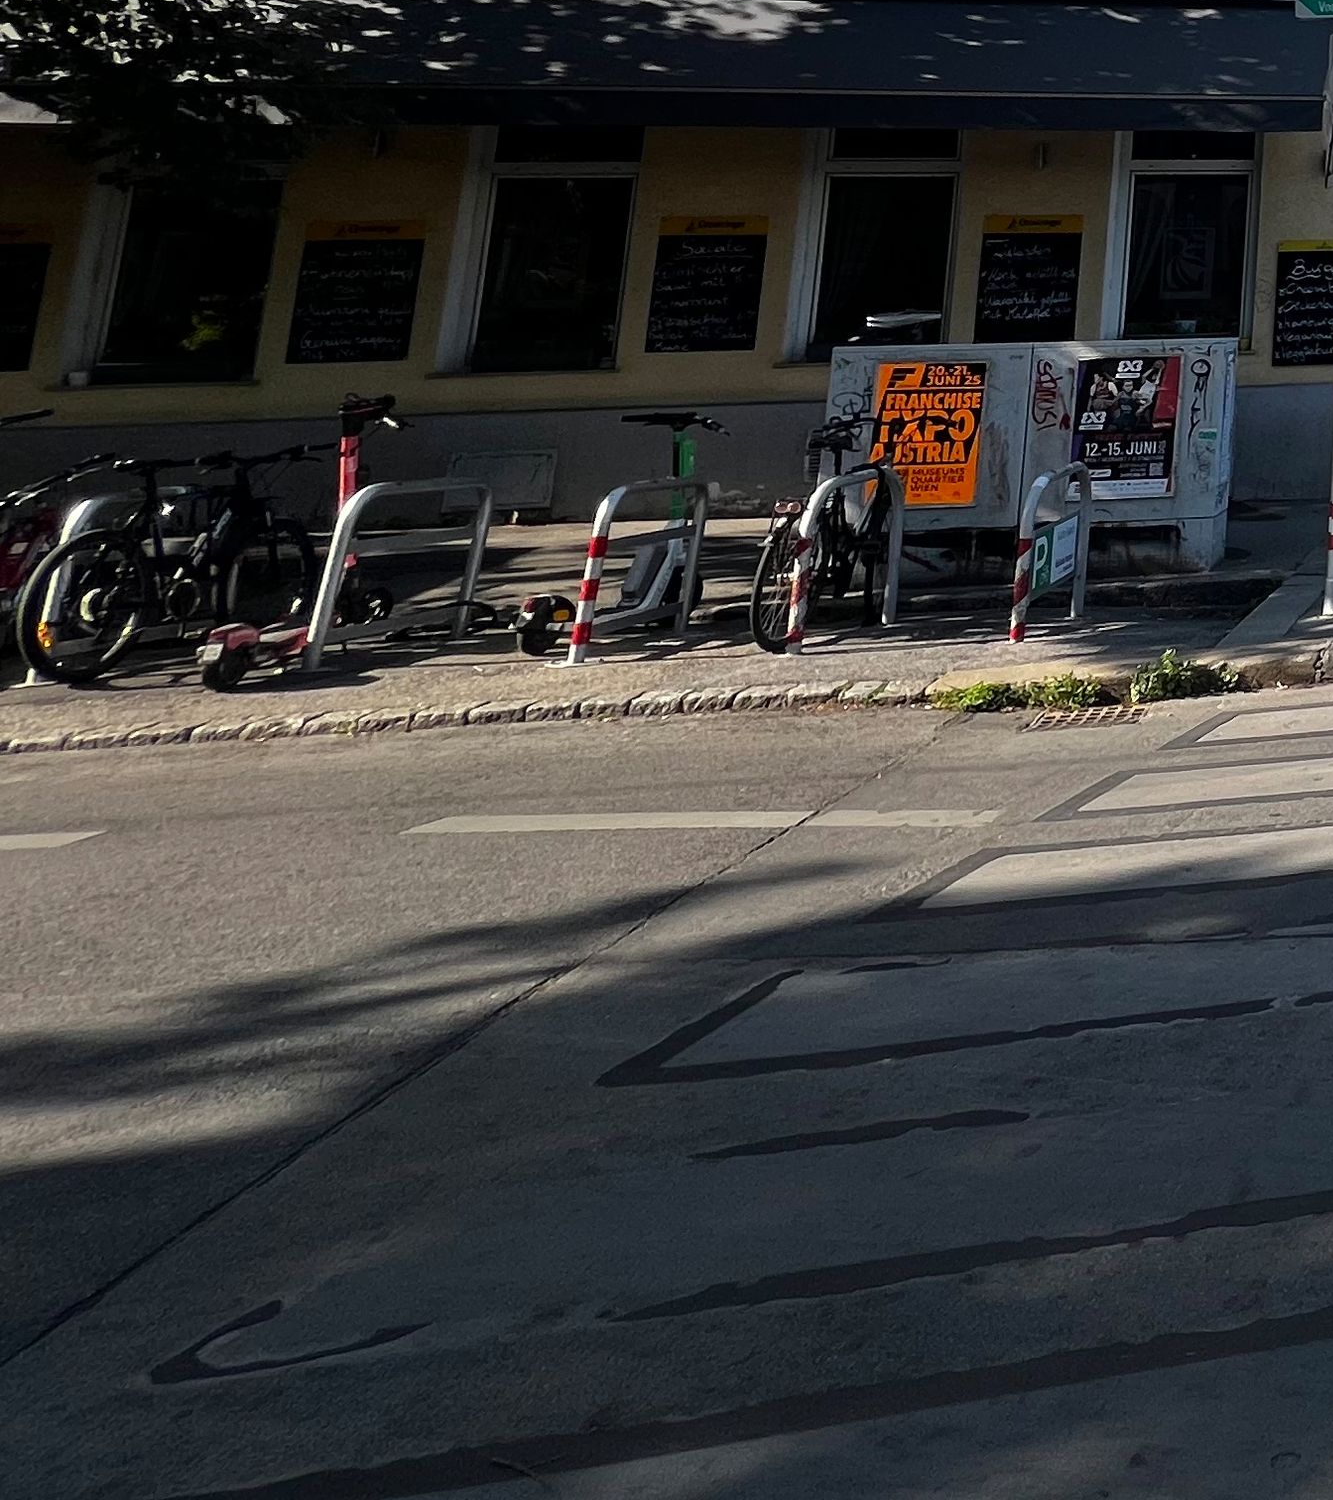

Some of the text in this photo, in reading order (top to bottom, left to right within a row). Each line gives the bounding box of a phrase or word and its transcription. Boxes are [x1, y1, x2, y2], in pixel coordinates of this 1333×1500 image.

[927, 365, 971, 376] 20.-21.
[926, 375, 982, 386] JUNI 25
[885, 392, 982, 410] FRANCHISE
[1125, 440, 1157, 455] JUNI
[911, 466, 965, 476] MUSEUMS
[911, 475, 965, 484] QUARTIER
[910, 482, 940, 493] WIEN
